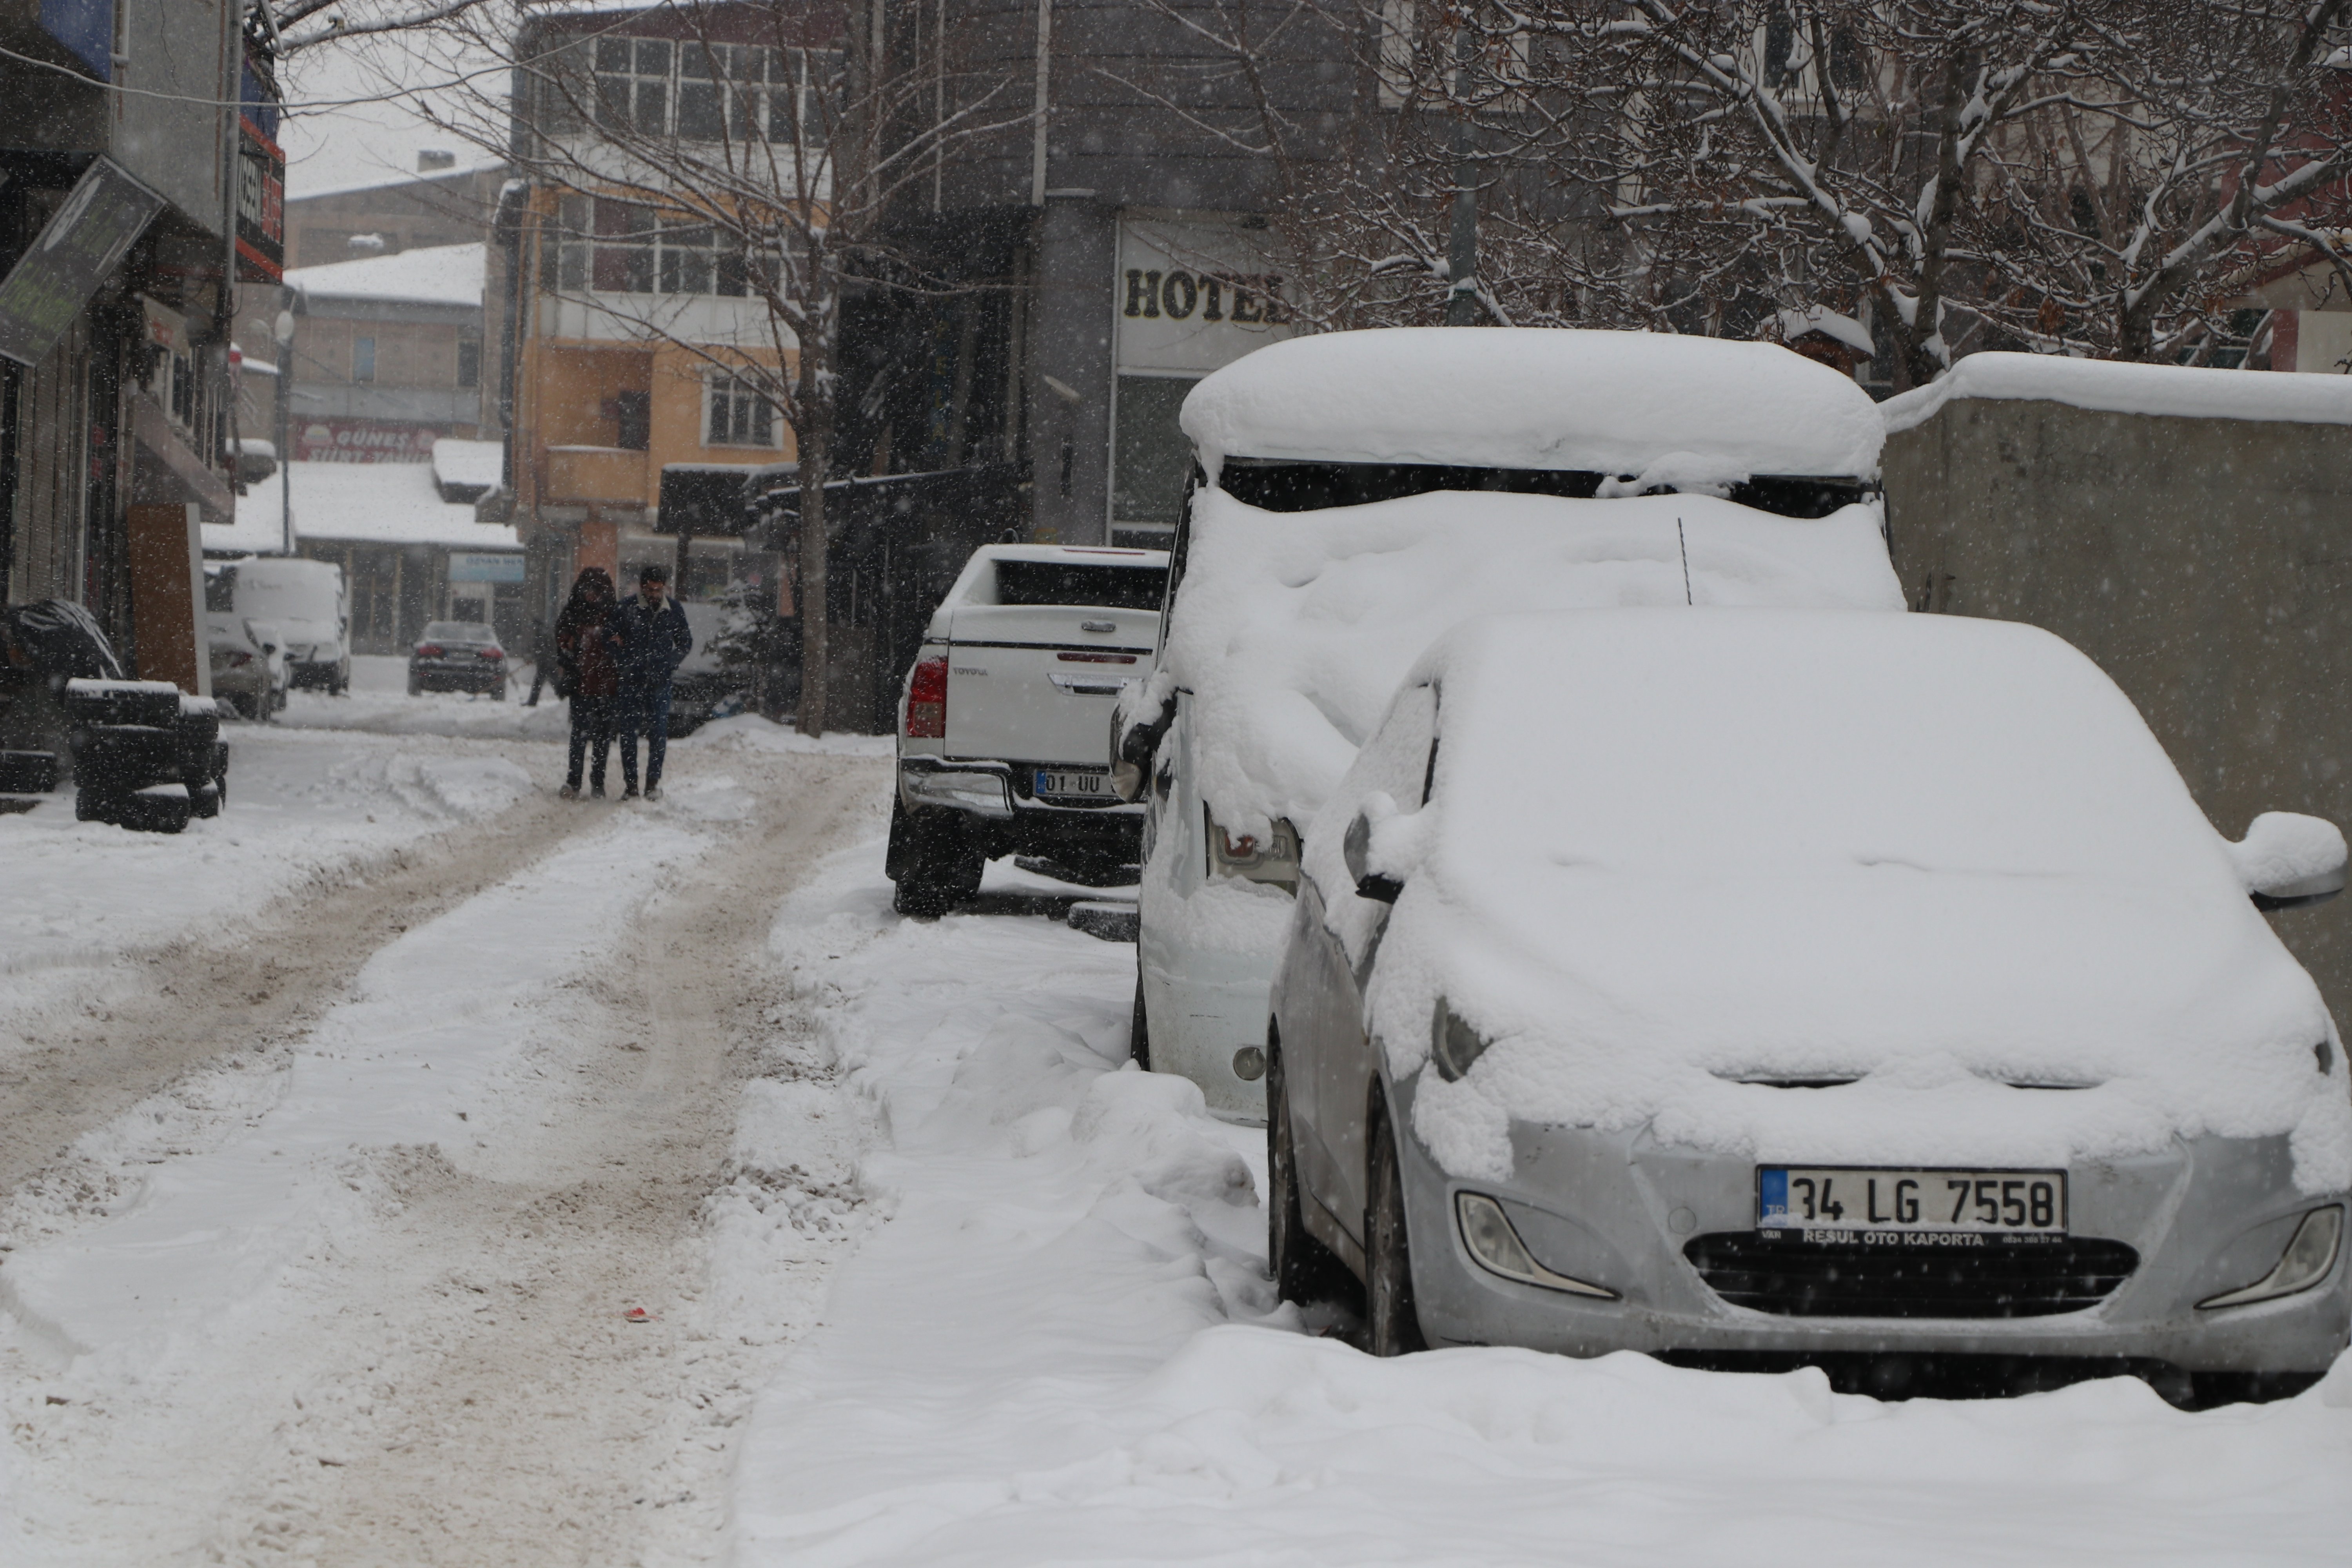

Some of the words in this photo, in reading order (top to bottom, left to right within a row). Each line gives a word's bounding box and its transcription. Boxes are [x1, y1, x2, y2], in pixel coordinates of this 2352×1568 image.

[1124, 269, 1290, 323] HOTEL
[1046, 775, 1065, 791] 01
[1078, 775, 1100, 793] UU
[1766, 1204, 1785, 1215] TR
[1792, 1178, 1844, 1221] 34
[1868, 1178, 1919, 1223] LG
[1947, 1180, 2054, 1227] 7558
[1762, 1230, 1782, 1240] VAN
[1864, 1231, 1899, 1245] OTO
[1904, 1232, 1985, 1246] KAPORTA
